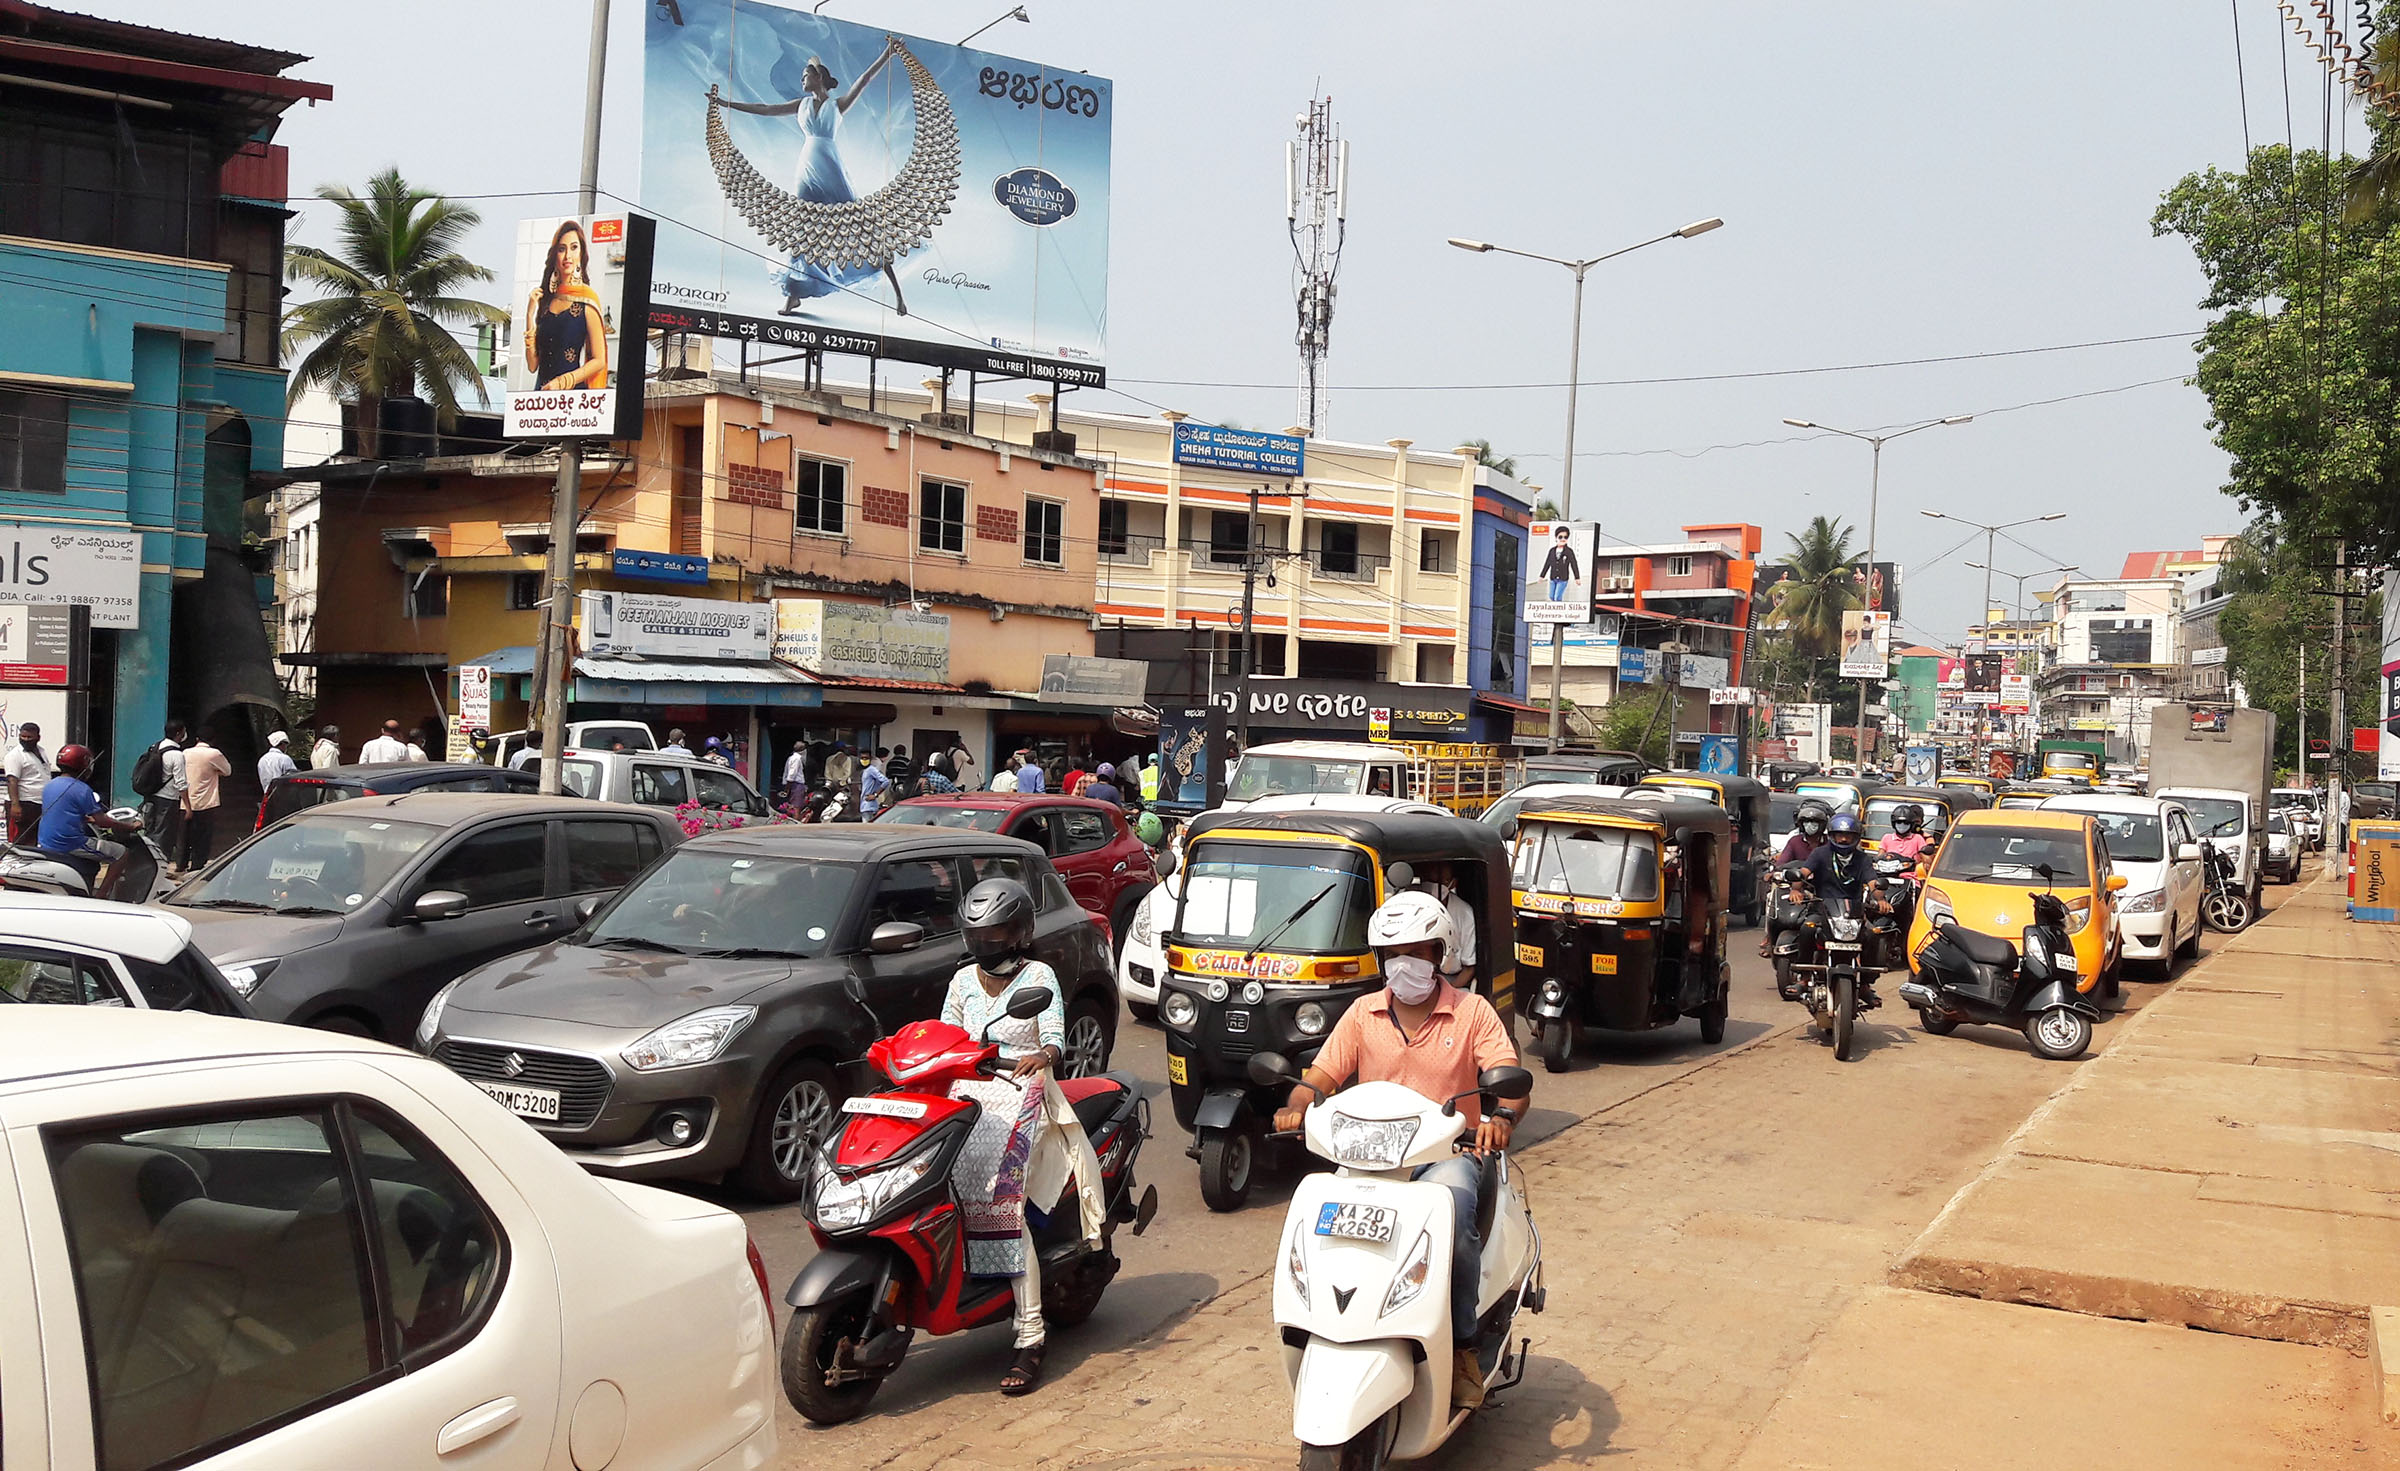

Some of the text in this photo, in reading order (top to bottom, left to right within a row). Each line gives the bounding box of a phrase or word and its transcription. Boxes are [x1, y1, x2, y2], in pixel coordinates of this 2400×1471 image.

[979, 66, 1099, 119] ಆಭರಣ
[1007, 183, 1065, 201] DIAMOND
[1006, 195, 1065, 213] JEWELLERY
[923, 268, 992, 292] Pure Passion
[784, 329, 817, 344] 0820
[822, 333, 878, 353] 4297777
[987, 358, 1100, 384] TOLL FREE 1800 5999 777
[1180, 443, 1298, 467] SNEHA TUTORIAL COLLEGE
[0, 541, 49, 586] ls
[24, 593, 46, 601] Call:
[50, 595, 68, 603] +91
[70, 595, 100, 604] 98867
[103, 597, 133, 606] 97358
[1527, 603, 1587, 612] Jayalaxmi Silks
[617, 607, 750, 629] GEETHANJALI MOBILES
[645, 626, 729, 639] SALES & SERVICE
[811, 633, 819, 642] &
[611, 646, 633, 654] SONY
[789, 646, 818, 657] FRUITS
[829, 645, 942, 669] CASHEWS & DRY FRUITS
[1407, 710, 1415, 720] &
[1416, 711, 1450, 722] SPIRITS
[1370, 729, 1389, 739] MRP
[2367, 850, 2385, 903] Whirlpool
[1522, 954, 1539, 963] 595
[1595, 956, 1614, 965] FOR
[1337, 1204, 1385, 1224] KA 20
[1330, 1220, 1390, 1241] EK2692
